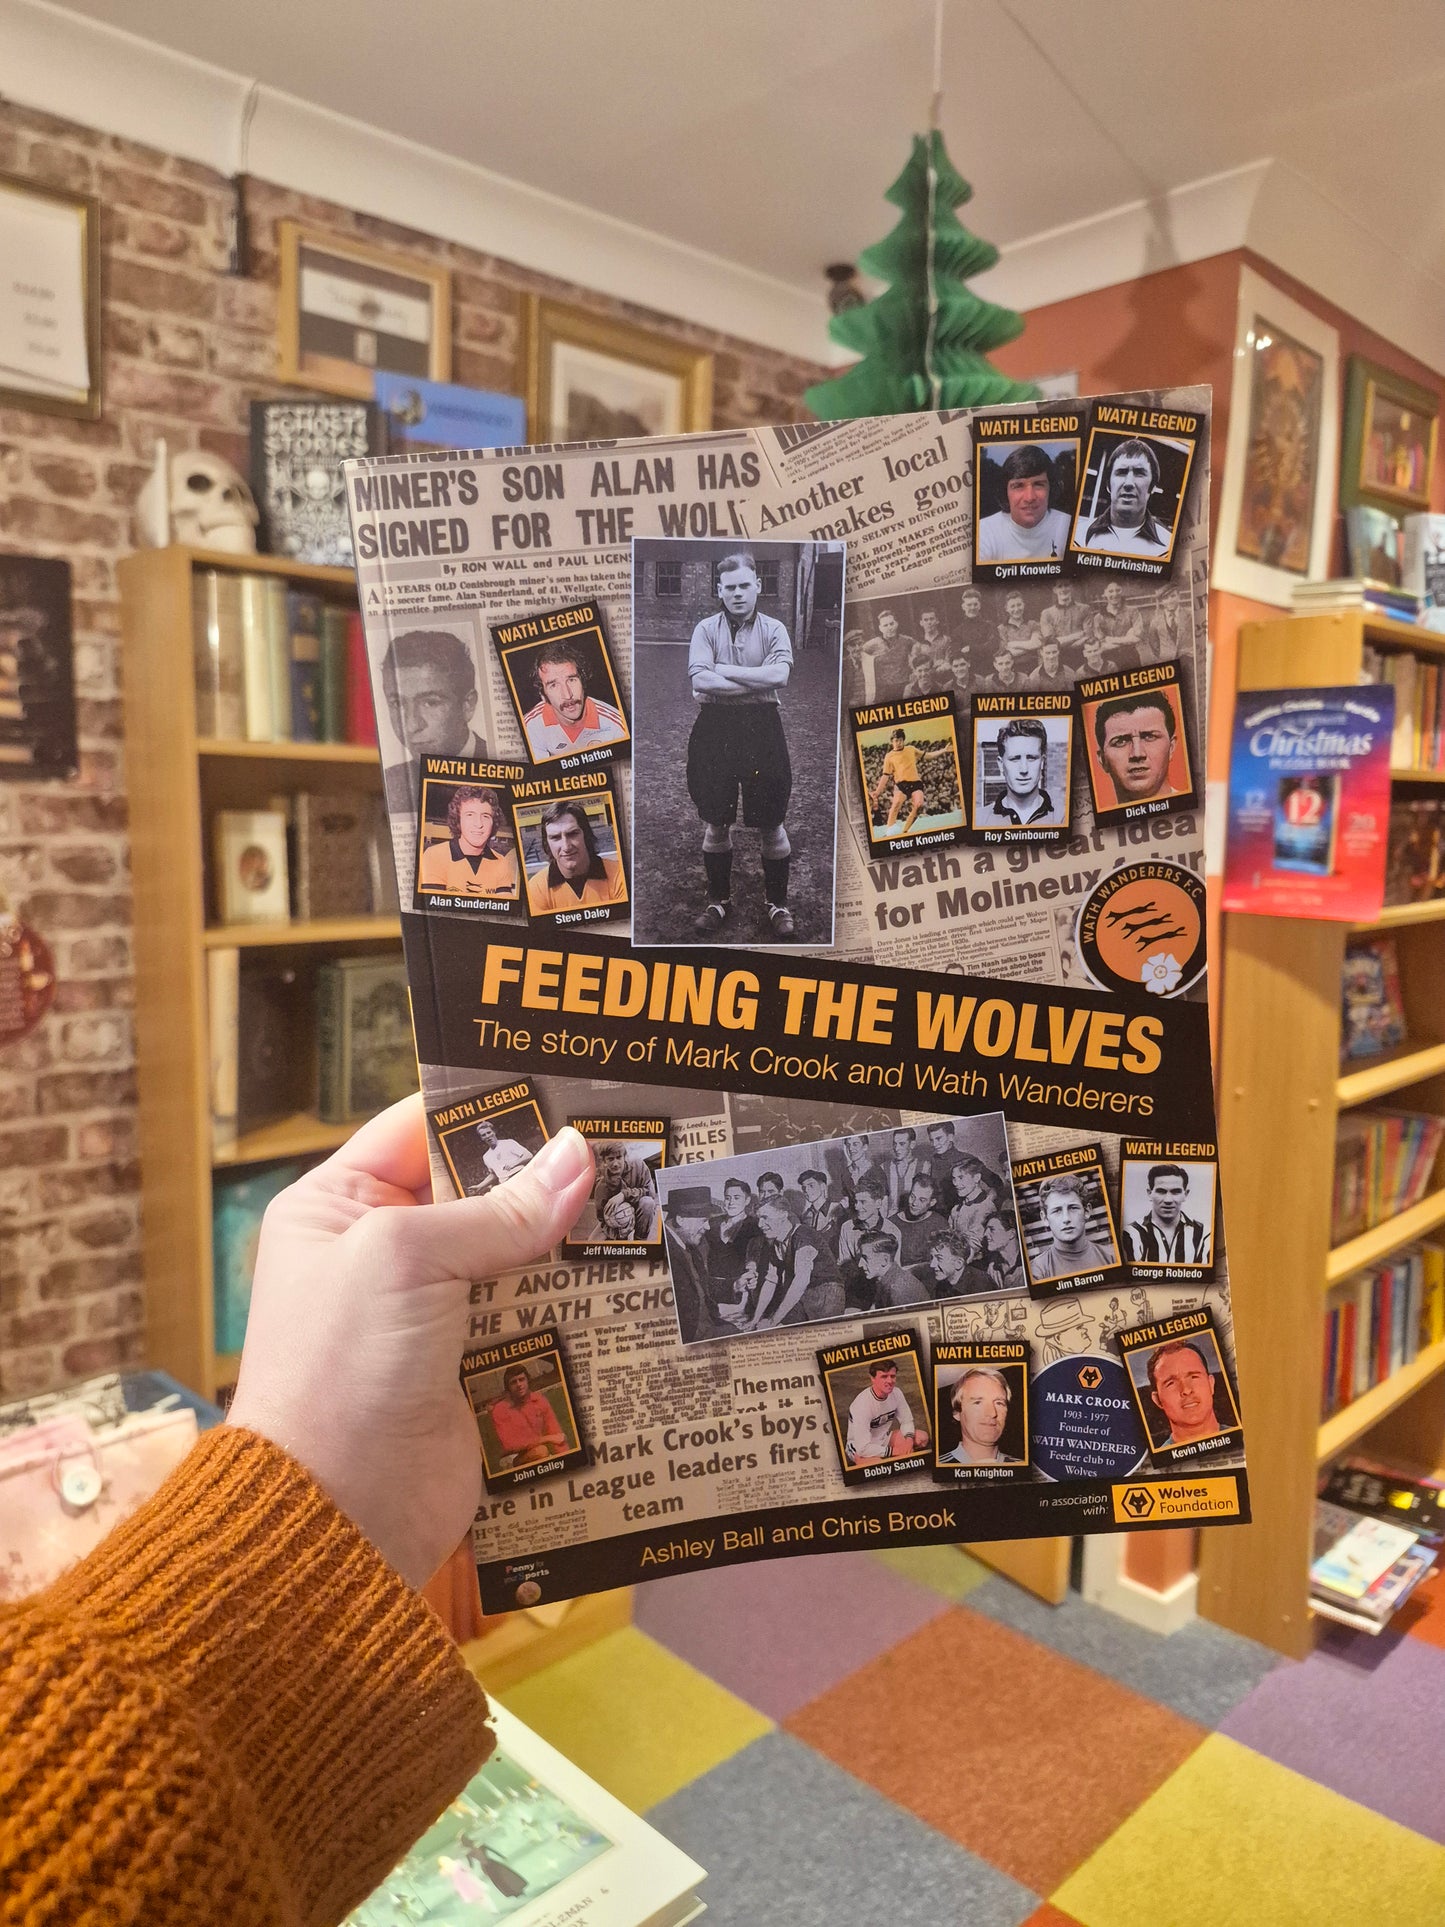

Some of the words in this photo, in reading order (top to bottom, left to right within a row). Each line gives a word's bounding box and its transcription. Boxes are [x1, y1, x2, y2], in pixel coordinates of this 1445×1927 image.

[979, 419, 1020, 436] WATH
[1023, 416, 1079, 434] LEGEND
[1097, 407, 1138, 425] WATH
[1140, 412, 1197, 433] LEGEND
[354, 469, 479, 512] MINER'S
[503, 464, 565, 502] SON
[590, 456, 675, 497] ALAN
[697, 451, 761, 490] HAS
[759, 474, 865, 532] Another
[882, 435, 948, 483] local
[809, 500, 896, 540] makes
[862, 521, 906, 544] SELWYN
[908, 500, 959, 525] DUNFORD
[357, 518, 470, 560] SIGNED
[492, 512, 552, 550] FOR
[575, 507, 634, 545] THE
[872, 541, 894, 556] BOY
[898, 525, 936, 546] MAKES
[443, 564, 457, 576] By
[462, 561, 487, 573] RON
[493, 558, 527, 570] WALL
[533, 556, 552, 568] and
[558, 555, 588, 567] PAUL
[995, 565, 1017, 577] Cyril
[1019, 564, 1061, 575] Knowles
[1077, 553, 1102, 567] Keith
[1104, 557, 1163, 573] Burkinshaw
[498, 621, 539, 644] WATH
[541, 607, 594, 632] LEGEND
[1081, 677, 1120, 698] WATH
[1122, 665, 1175, 689] LEGEND
[855, 706, 895, 725] WATH
[896, 696, 949, 718] LEGEND
[977, 697, 1017, 711] WATH
[1019, 696, 1071, 711] LEGEND
[1251, 727, 1373, 757] Christmas
[426, 759, 467, 776] WATH
[470, 762, 525, 780] LEGEND
[560, 755, 579, 770] Bob
[581, 748, 613, 765] Hatton
[512, 779, 551, 798] WATH
[554, 772, 608, 791] LEGEND
[1125, 805, 1147, 818] Dick
[1148, 800, 1169, 813] Neal
[889, 838, 914, 851] Peter
[915, 830, 955, 846] Knowles
[984, 831, 1003, 842] Roy
[1004, 830, 1060, 841] Swinbourne
[867, 851, 961, 893] Wath
[973, 852, 994, 874] a
[1006, 827, 1105, 873] great
[1116, 814, 1197, 847] idea
[429, 896, 452, 908] Alan
[454, 898, 510, 911] Sunderland
[874, 900, 925, 931] for
[936, 868, 1102, 920] Molineux
[1084, 903, 1101, 944] WATH
[1098, 865, 1182, 899] WANDERERS
[555, 912, 582, 925] Steve
[584, 907, 611, 923] Daley
[481, 944, 761, 1031] FEEDING
[779, 975, 898, 1046] THE
[916, 990, 1164, 1075] WOLVES
[472, 1018, 531, 1051] The
[541, 1028, 618, 1065] story
[626, 1036, 658, 1063] of
[665, 1037, 741, 1071] Mark
[749, 1047, 838, 1082] Crook
[847, 1062, 904, 1088] and
[913, 1064, 988, 1097] Wath
[999, 1074, 1156, 1116] Wanderers
[434, 1103, 476, 1127] WATH
[477, 1083, 531, 1112] LEGEND
[572, 1120, 611, 1133] WATH
[614, 1120, 664, 1134] LEGEND
[673, 1128, 727, 1148] MILES
[1126, 1142, 1163, 1155] WATH
[1165, 1142, 1215, 1157] LEGEND
[1013, 1160, 1046, 1178] WATH
[1049, 1148, 1097, 1170] LEGEND
[583, 1246, 601, 1256] Jeff
[603, 1246, 647, 1256] Wealands
[514, 1262, 635, 1297] ANOTHER
[1056, 1279, 1072, 1291] Jim
[1074, 1273, 1104, 1287] Barron
[1132, 1268, 1164, 1279] George
[1165, 1267, 1202, 1279] Robledo
[516, 1298, 591, 1329] WATH
[1120, 1327, 1157, 1347] WATH
[1160, 1312, 1208, 1336] LEGEND
[462, 1348, 500, 1371] WATH
[504, 1333, 553, 1359] LEGEND
[823, 1346, 860, 1365] WATH
[862, 1334, 911, 1357] LEGEND
[936, 1346, 972, 1359] WATH
[975, 1344, 1024, 1358] LEGEND
[770, 1374, 816, 1392] man
[1046, 1392, 1083, 1405] MARK
[1085, 1396, 1131, 1410] CROOK
[1062, 1409, 1082, 1419] 1903
[1090, 1412, 1110, 1422] 1977
[1059, 1422, 1098, 1435] Founder
[1100, 1426, 1112, 1436] of
[588, 1434, 653, 1466] Mark
[663, 1418, 754, 1451] Crook's
[760, 1414, 817, 1439] boys
[1032, 1435, 1065, 1447] WATH
[1066, 1439, 1137, 1455] WANDERERS
[1172, 1447, 1197, 1460] Kevin
[1198, 1436, 1231, 1452] McHale
[864, 1465, 892, 1478] Bobby
[894, 1458, 925, 1473] Saxton
[1049, 1451, 1081, 1463] Feeder
[1083, 1454, 1104, 1465] club
[1105, 1457, 1115, 1466] to
[474, 1500, 516, 1522] are
[530, 1489, 553, 1510] in
[568, 1469, 656, 1502] League
[668, 1450, 758, 1482] leaders
[769, 1441, 821, 1464] first
[513, 1468, 536, 1483] John
[537, 1460, 565, 1475] Galley
[954, 1469, 973, 1478] Ken
[974, 1468, 1014, 1480] Knighton
[1065, 1465, 1098, 1477] Wolves
[1039, 1498, 1048, 1508] in
[1051, 1494, 1108, 1507] association
[1157, 1487, 1208, 1500] Wolves
[623, 1495, 684, 1521] team
[1082, 1506, 1109, 1516] with:
[1159, 1499, 1234, 1514] Foundation
[639, 1537, 716, 1567] Ashley
[723, 1527, 764, 1551] Ball
[772, 1520, 815, 1543] and
[822, 1514, 881, 1537] Chris
[889, 1508, 957, 1532] Brook
[505, 1562, 535, 1574] Penny
